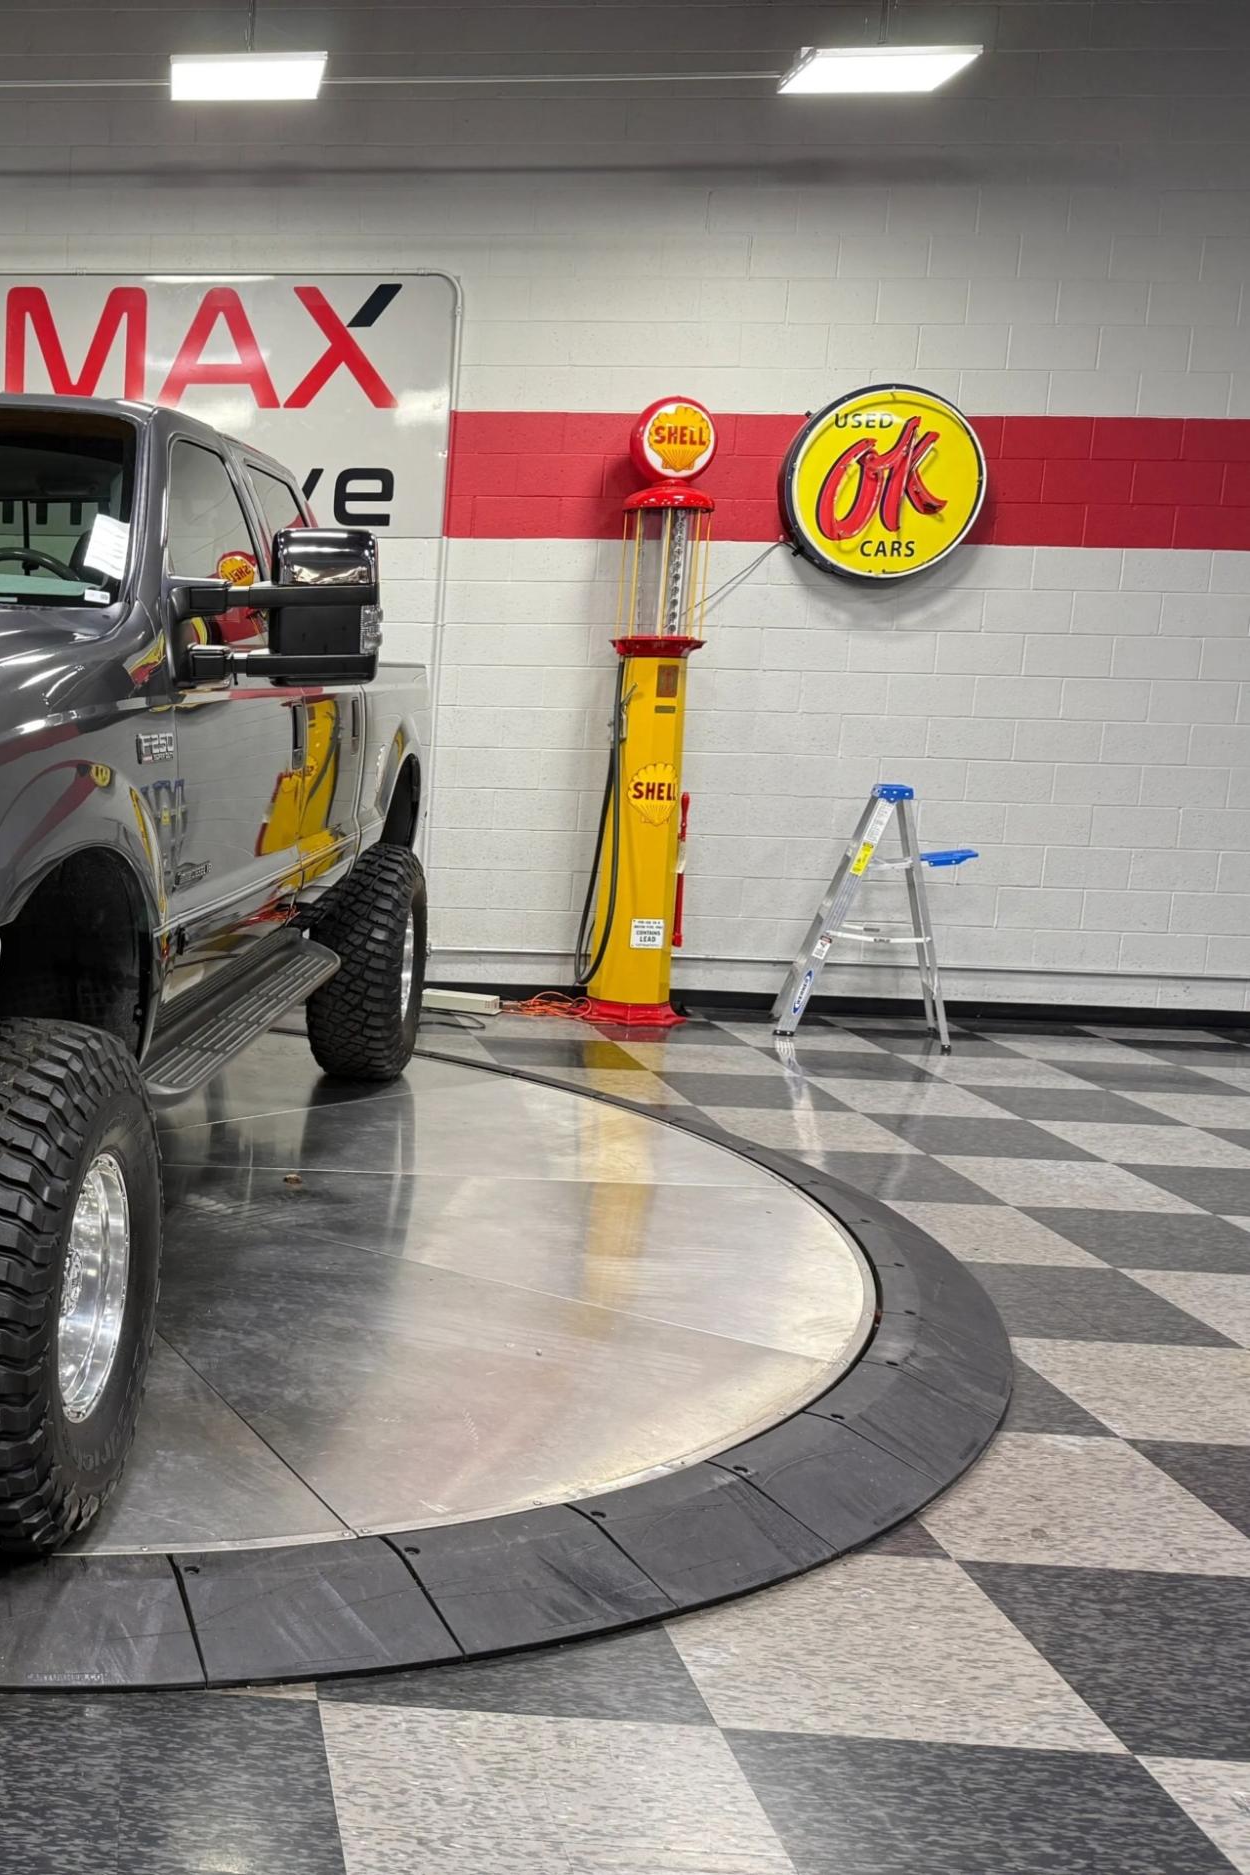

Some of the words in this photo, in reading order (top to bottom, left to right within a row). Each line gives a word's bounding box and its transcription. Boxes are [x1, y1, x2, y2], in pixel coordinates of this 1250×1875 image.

[4, 283, 404, 409] MAX
[834, 413, 894, 429] USED
[653, 425, 707, 446] SHELL
[816, 416, 948, 541] OK
[859, 540, 916, 558] CARS
